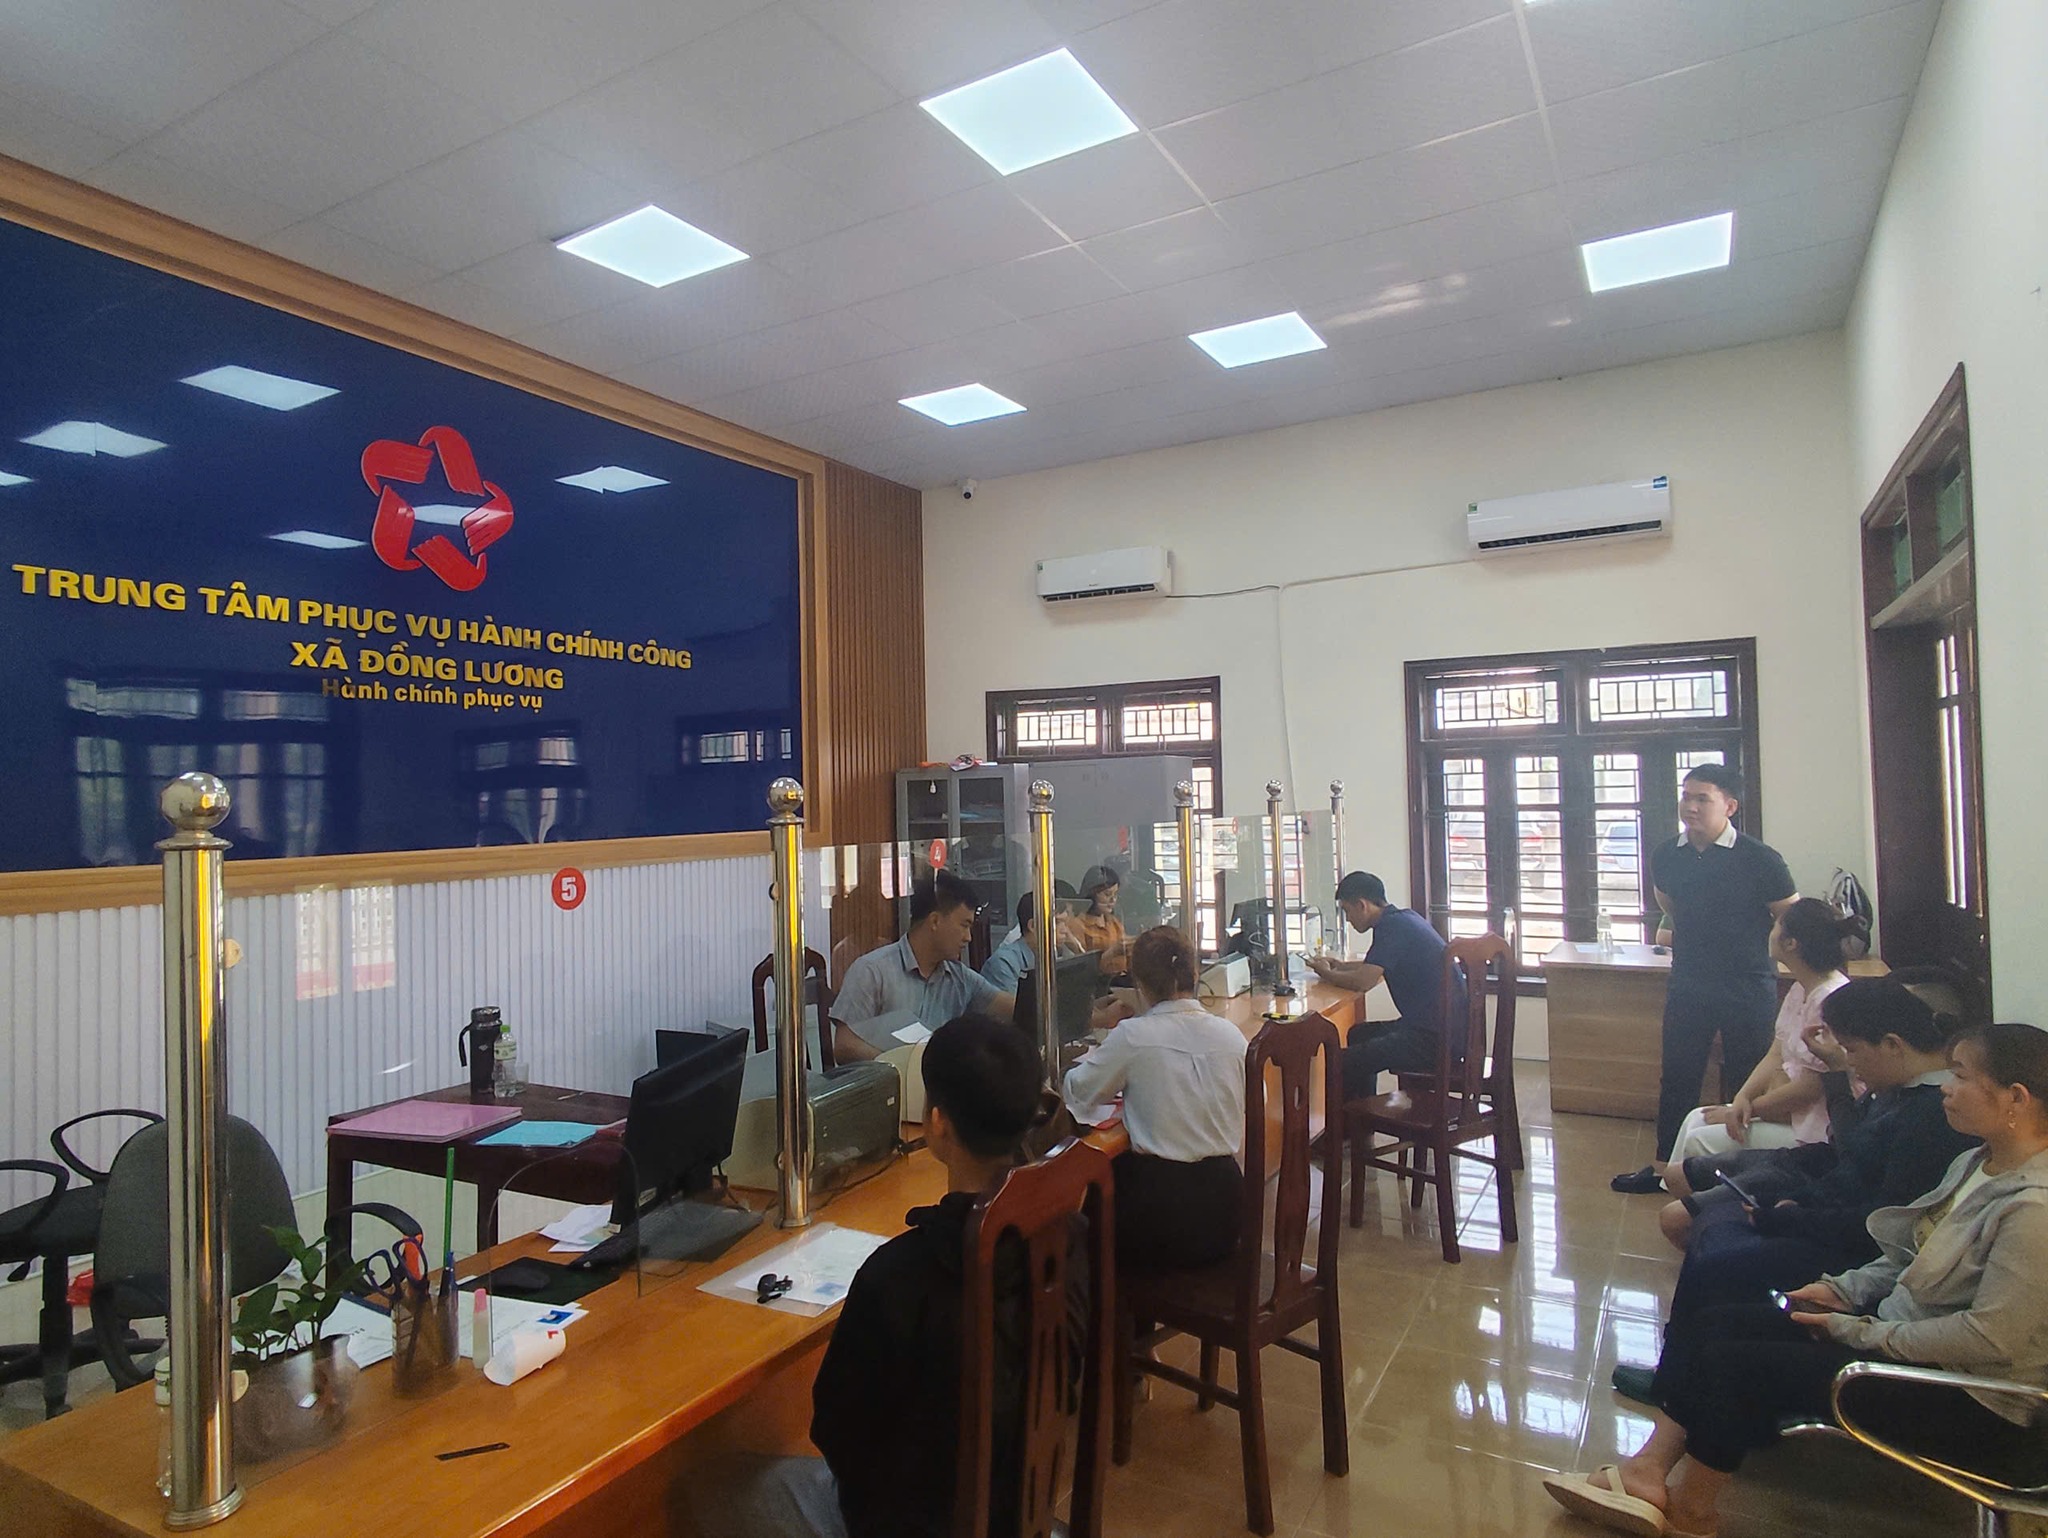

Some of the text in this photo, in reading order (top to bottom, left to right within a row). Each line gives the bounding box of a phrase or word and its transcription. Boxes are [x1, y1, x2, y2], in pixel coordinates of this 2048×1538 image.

[12, 563, 692, 670] TRUNG TÂM PHỤC VỤ HÀNH CHÍNH CÔNG
[290, 637, 565, 690] XÃ ĐỒNG LƯƠNG
[322, 676, 543, 714] Hành chính phục vụ
[561, 876, 577, 901] 5
